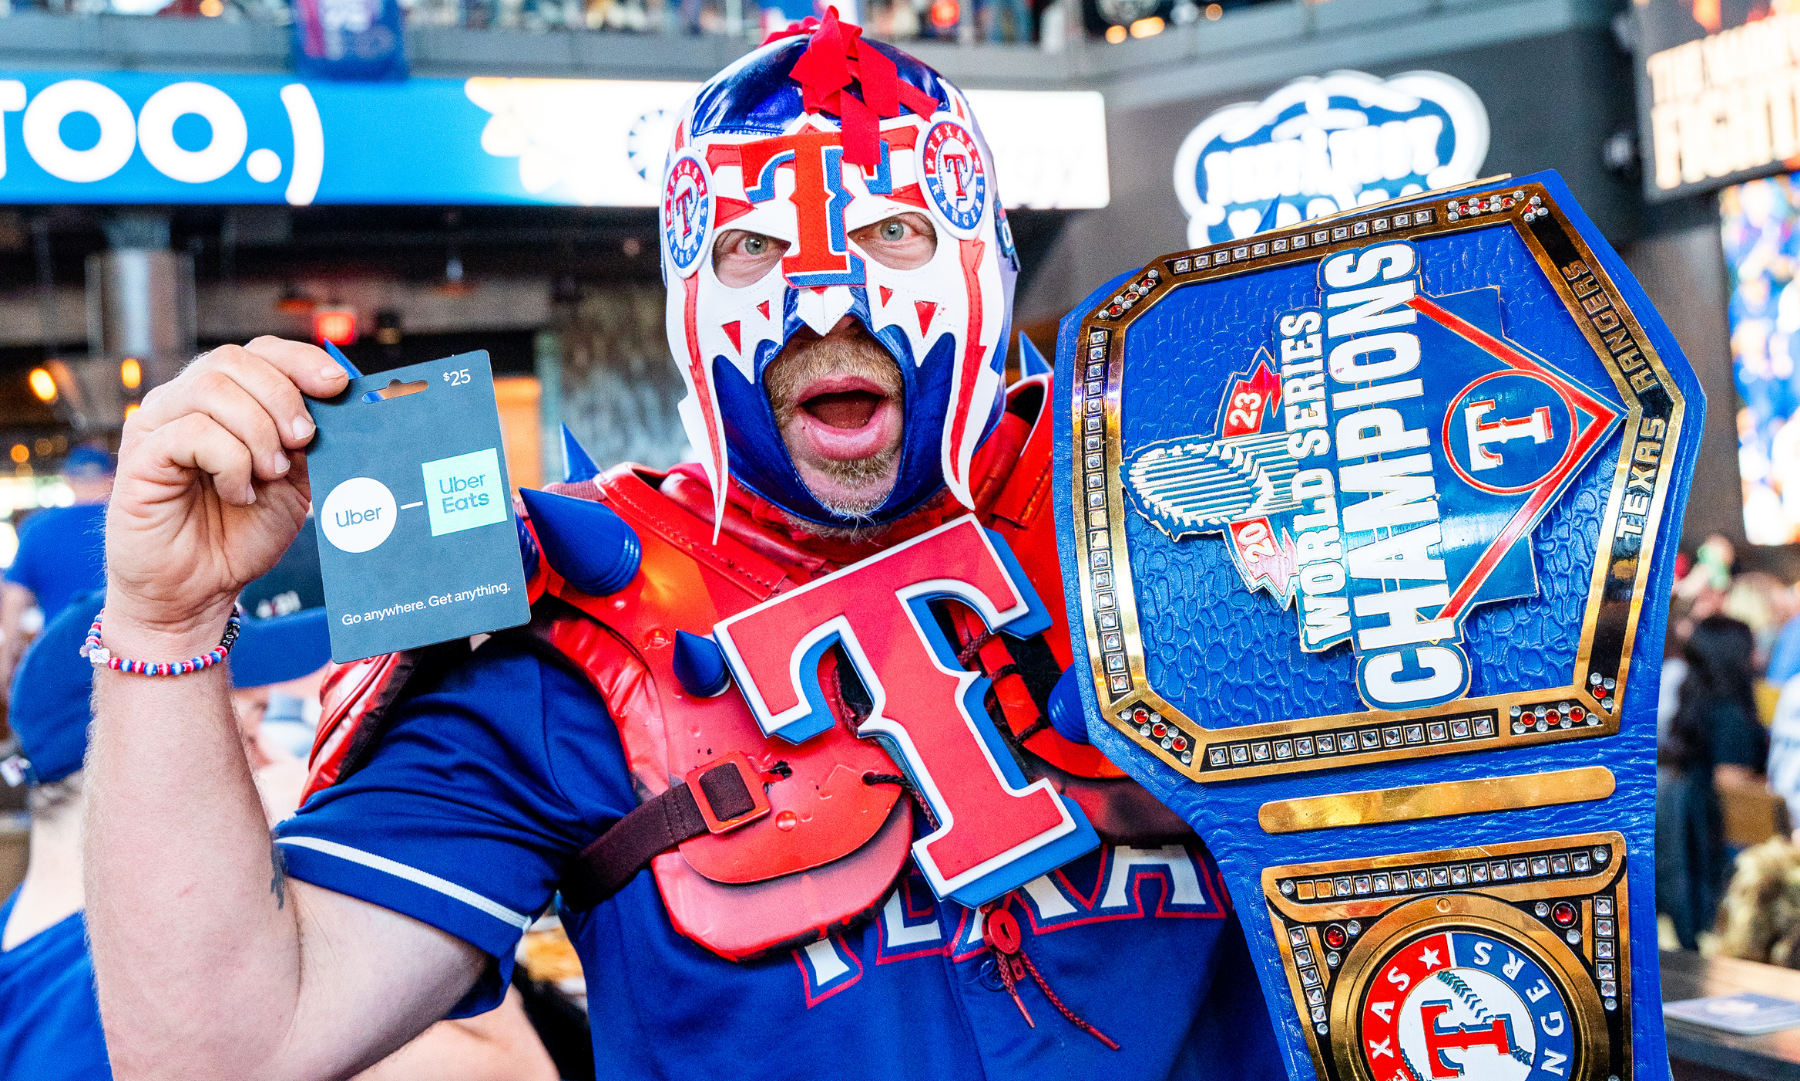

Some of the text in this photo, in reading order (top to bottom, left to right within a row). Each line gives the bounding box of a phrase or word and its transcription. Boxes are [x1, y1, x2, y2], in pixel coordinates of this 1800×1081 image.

[927, 125, 975, 152] TEXAS
[943, 154, 968, 200] T
[738, 131, 892, 288] T
[931, 184, 984, 226] RANGERS
[1562, 259, 1659, 395] RANGERS
[443, 368, 471, 386] $25
[1325, 243, 1463, 703] CHAMPIONS
[1465, 399, 1554, 472] T
[439, 473, 486, 494] Uber
[442, 492, 490, 514] Eats
[1229, 391, 1276, 564] 20 23
[1280, 311, 1351, 645] WORLD SERIES
[1617, 417, 1666, 539] TEXAS
[335, 506, 382, 528] Uber
[341, 581, 511, 625] Go anywhere. Get anything.
[712, 512, 1101, 909] T
[1420, 999, 1518, 1080] T
[1474, 941, 1568, 1076] NGERS
